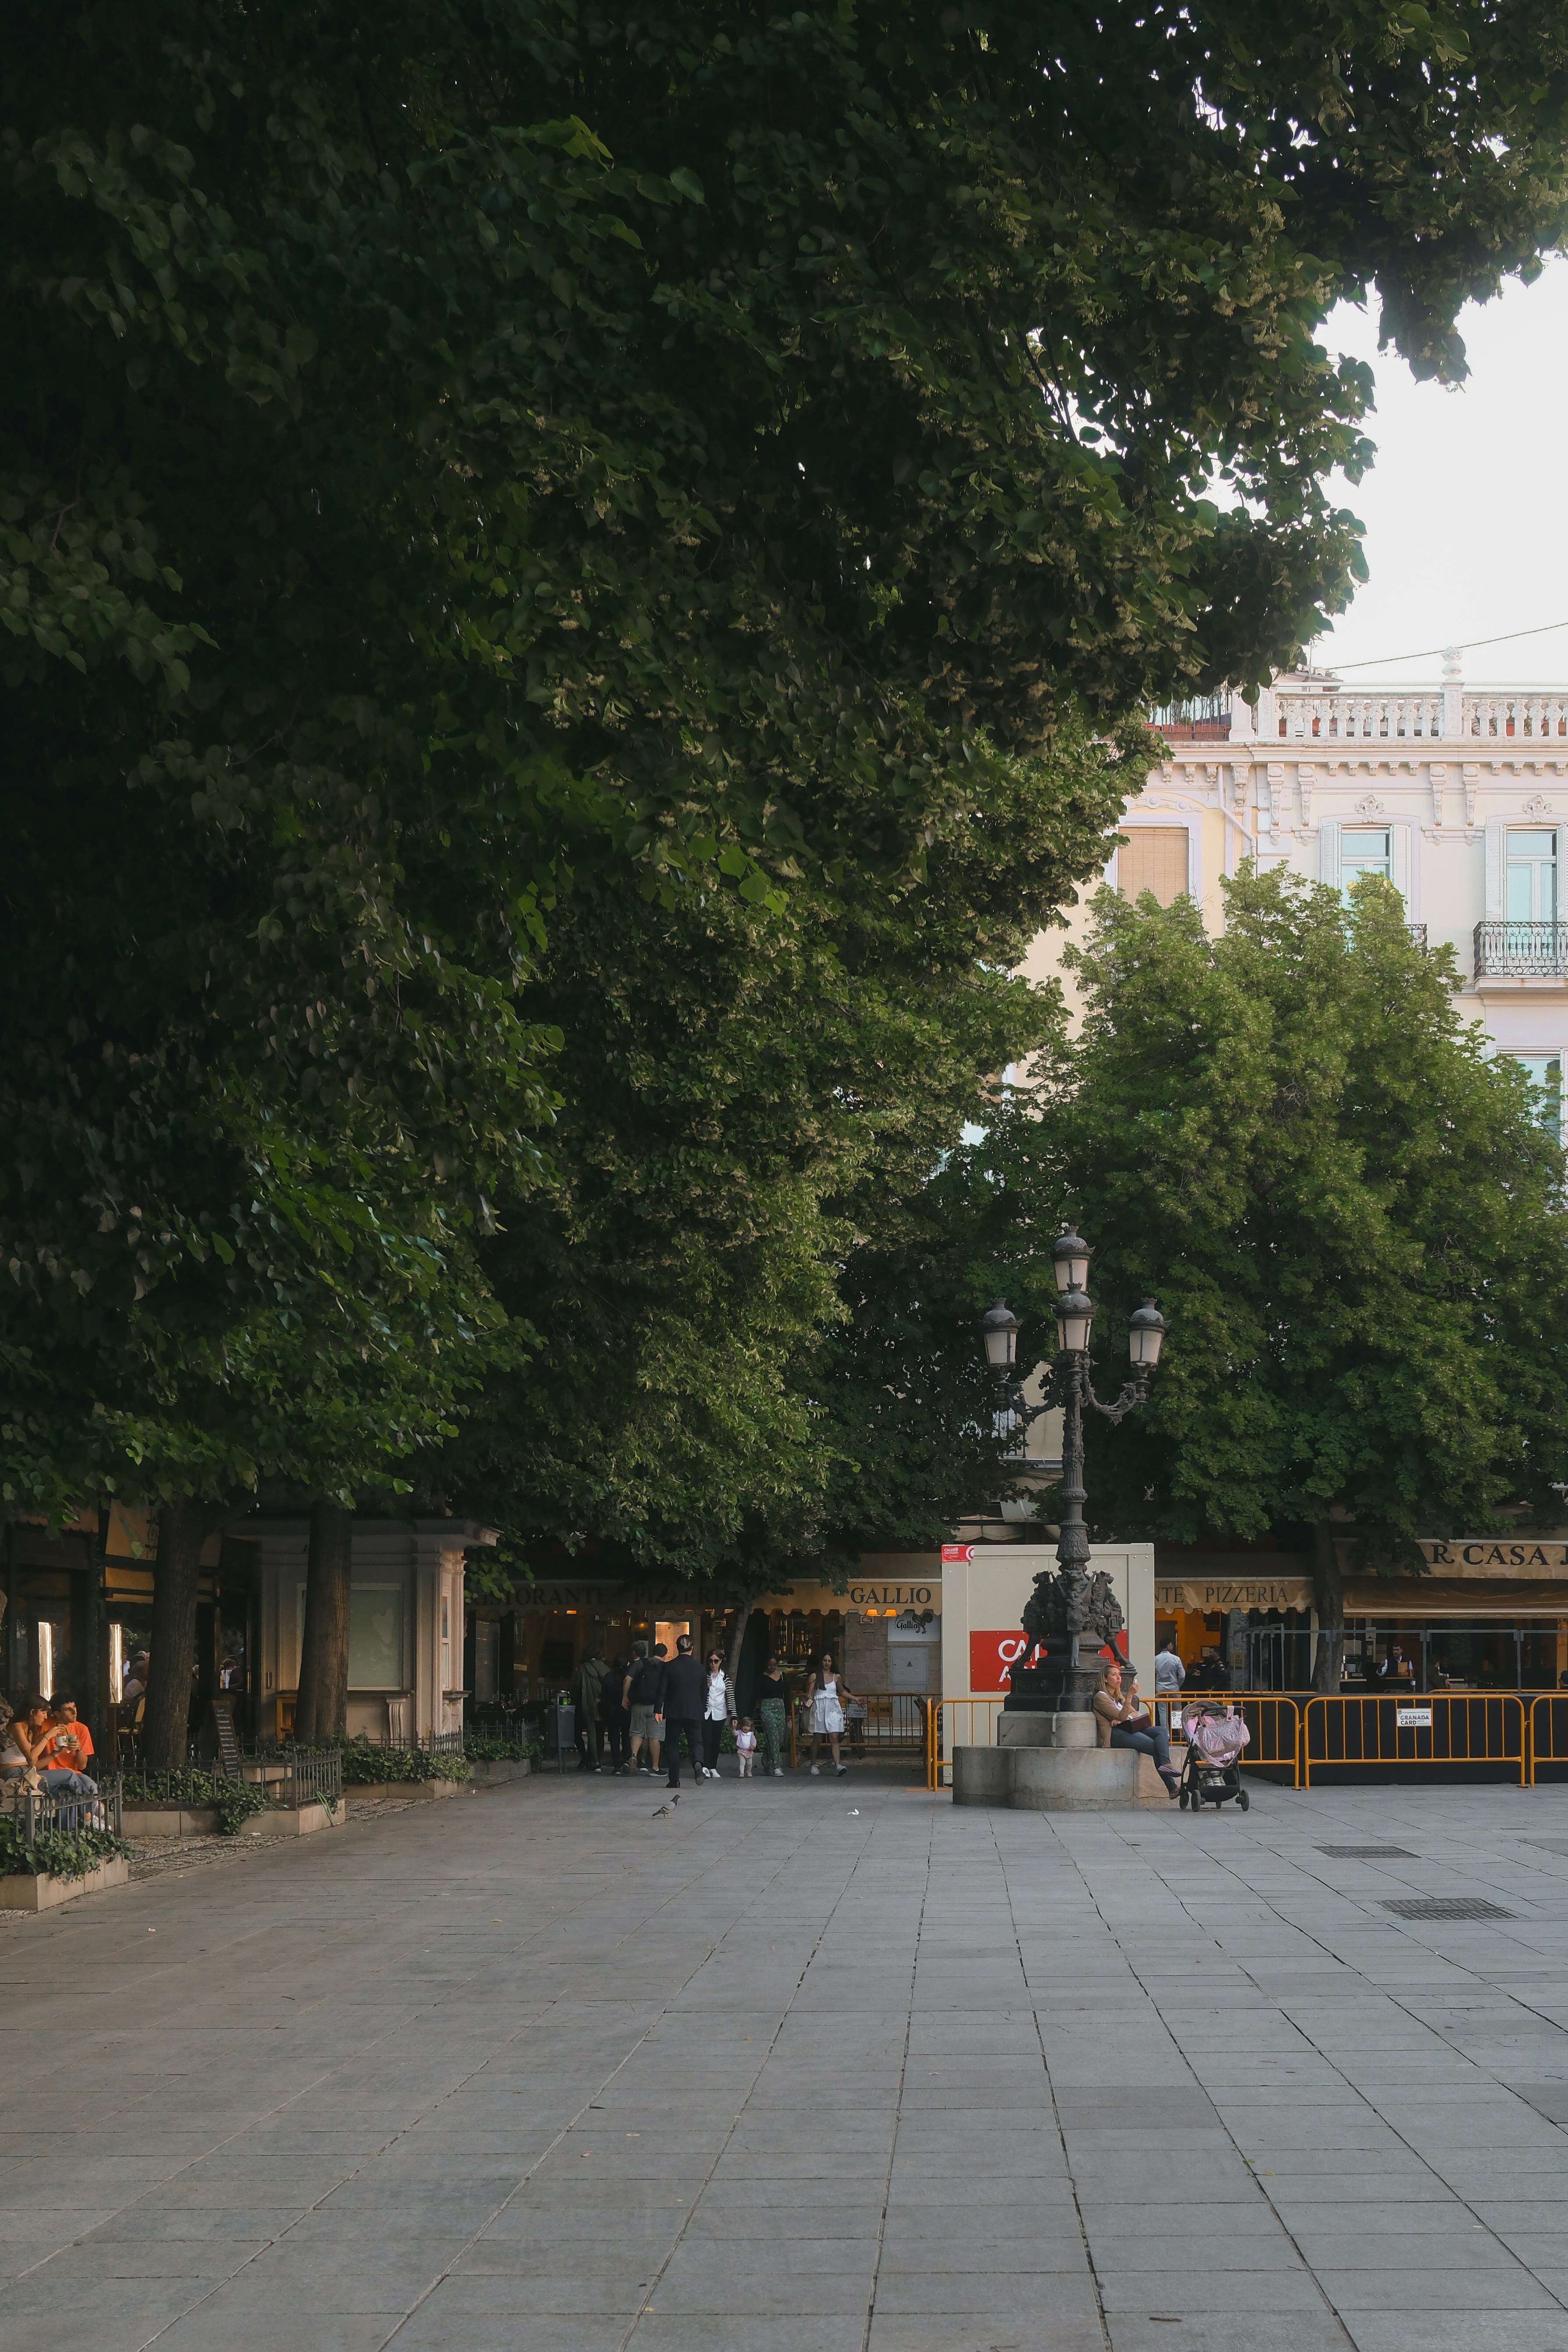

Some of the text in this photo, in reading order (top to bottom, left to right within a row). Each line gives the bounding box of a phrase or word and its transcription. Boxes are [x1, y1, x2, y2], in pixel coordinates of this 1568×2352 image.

[1463, 1545, 1550, 1565] CASA
[850, 1587, 931, 1604] GALLIO
[1205, 1586, 1289, 1603] PIZZERIA
[897, 1620, 918, 1631] Gallio
